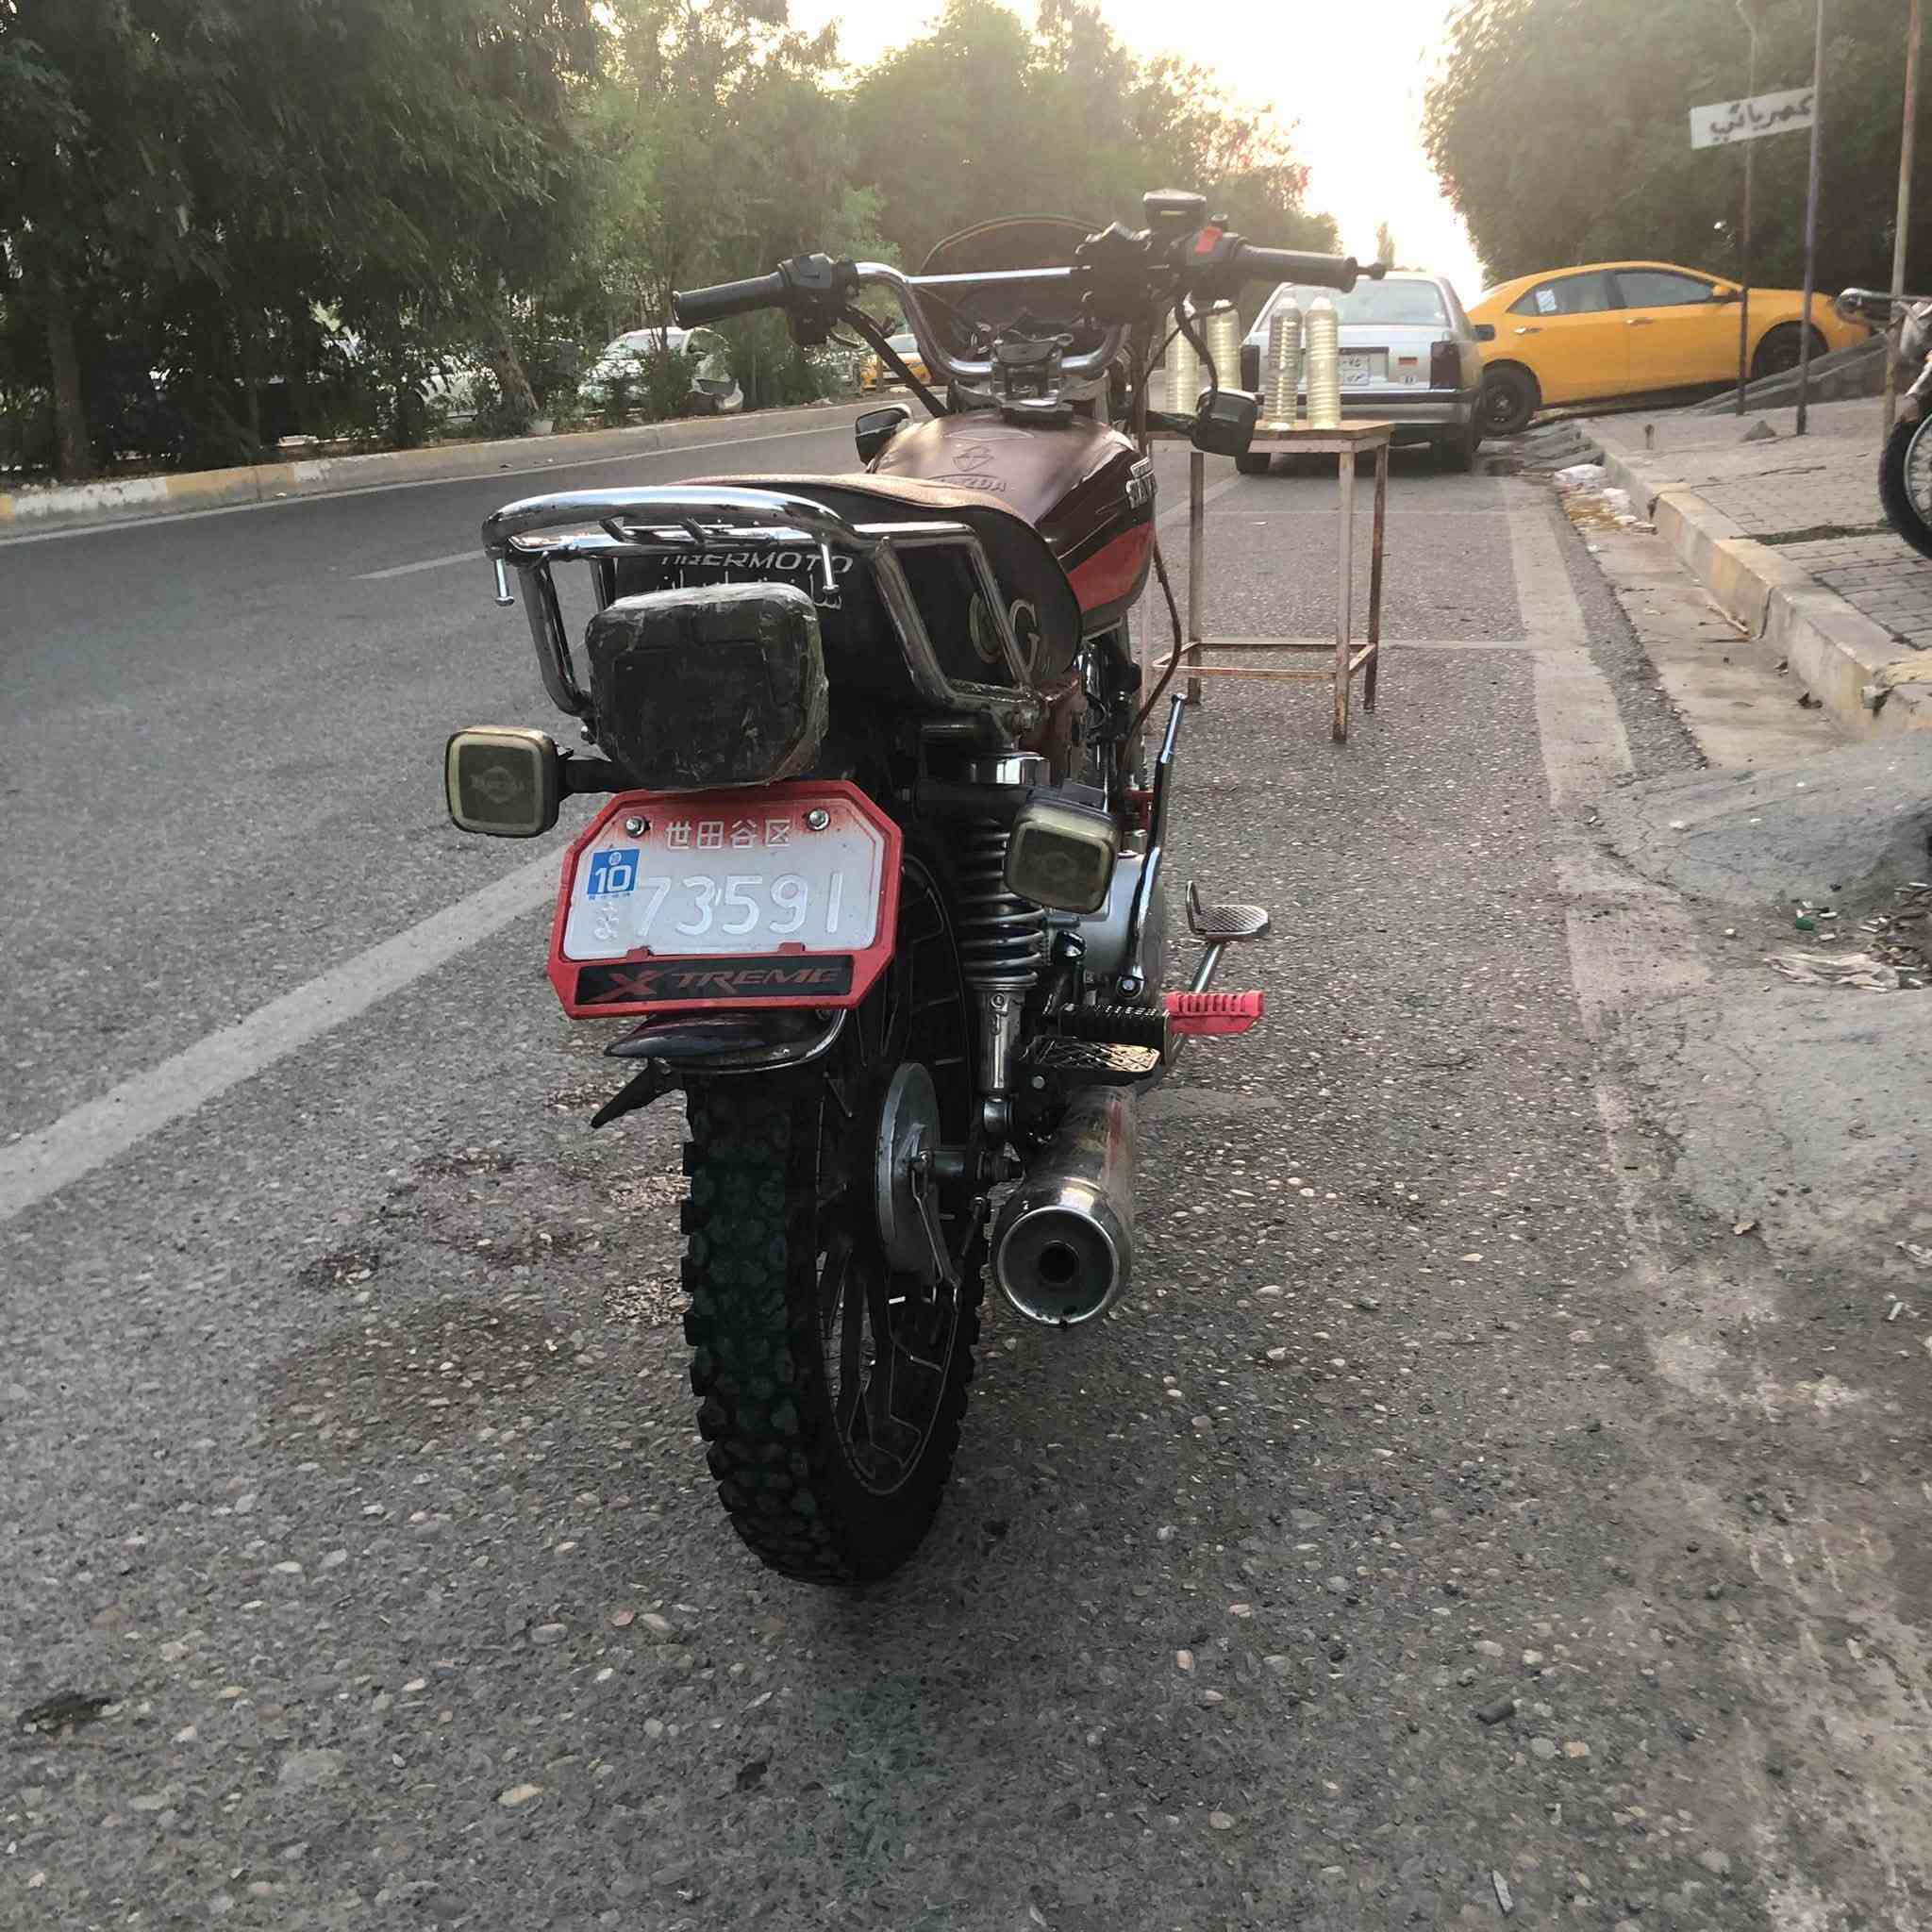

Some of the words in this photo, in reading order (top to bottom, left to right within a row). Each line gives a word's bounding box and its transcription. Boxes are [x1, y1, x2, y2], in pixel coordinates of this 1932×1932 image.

[666, 819, 791, 850] 世田谷区
[595, 865, 631, 893] 10
